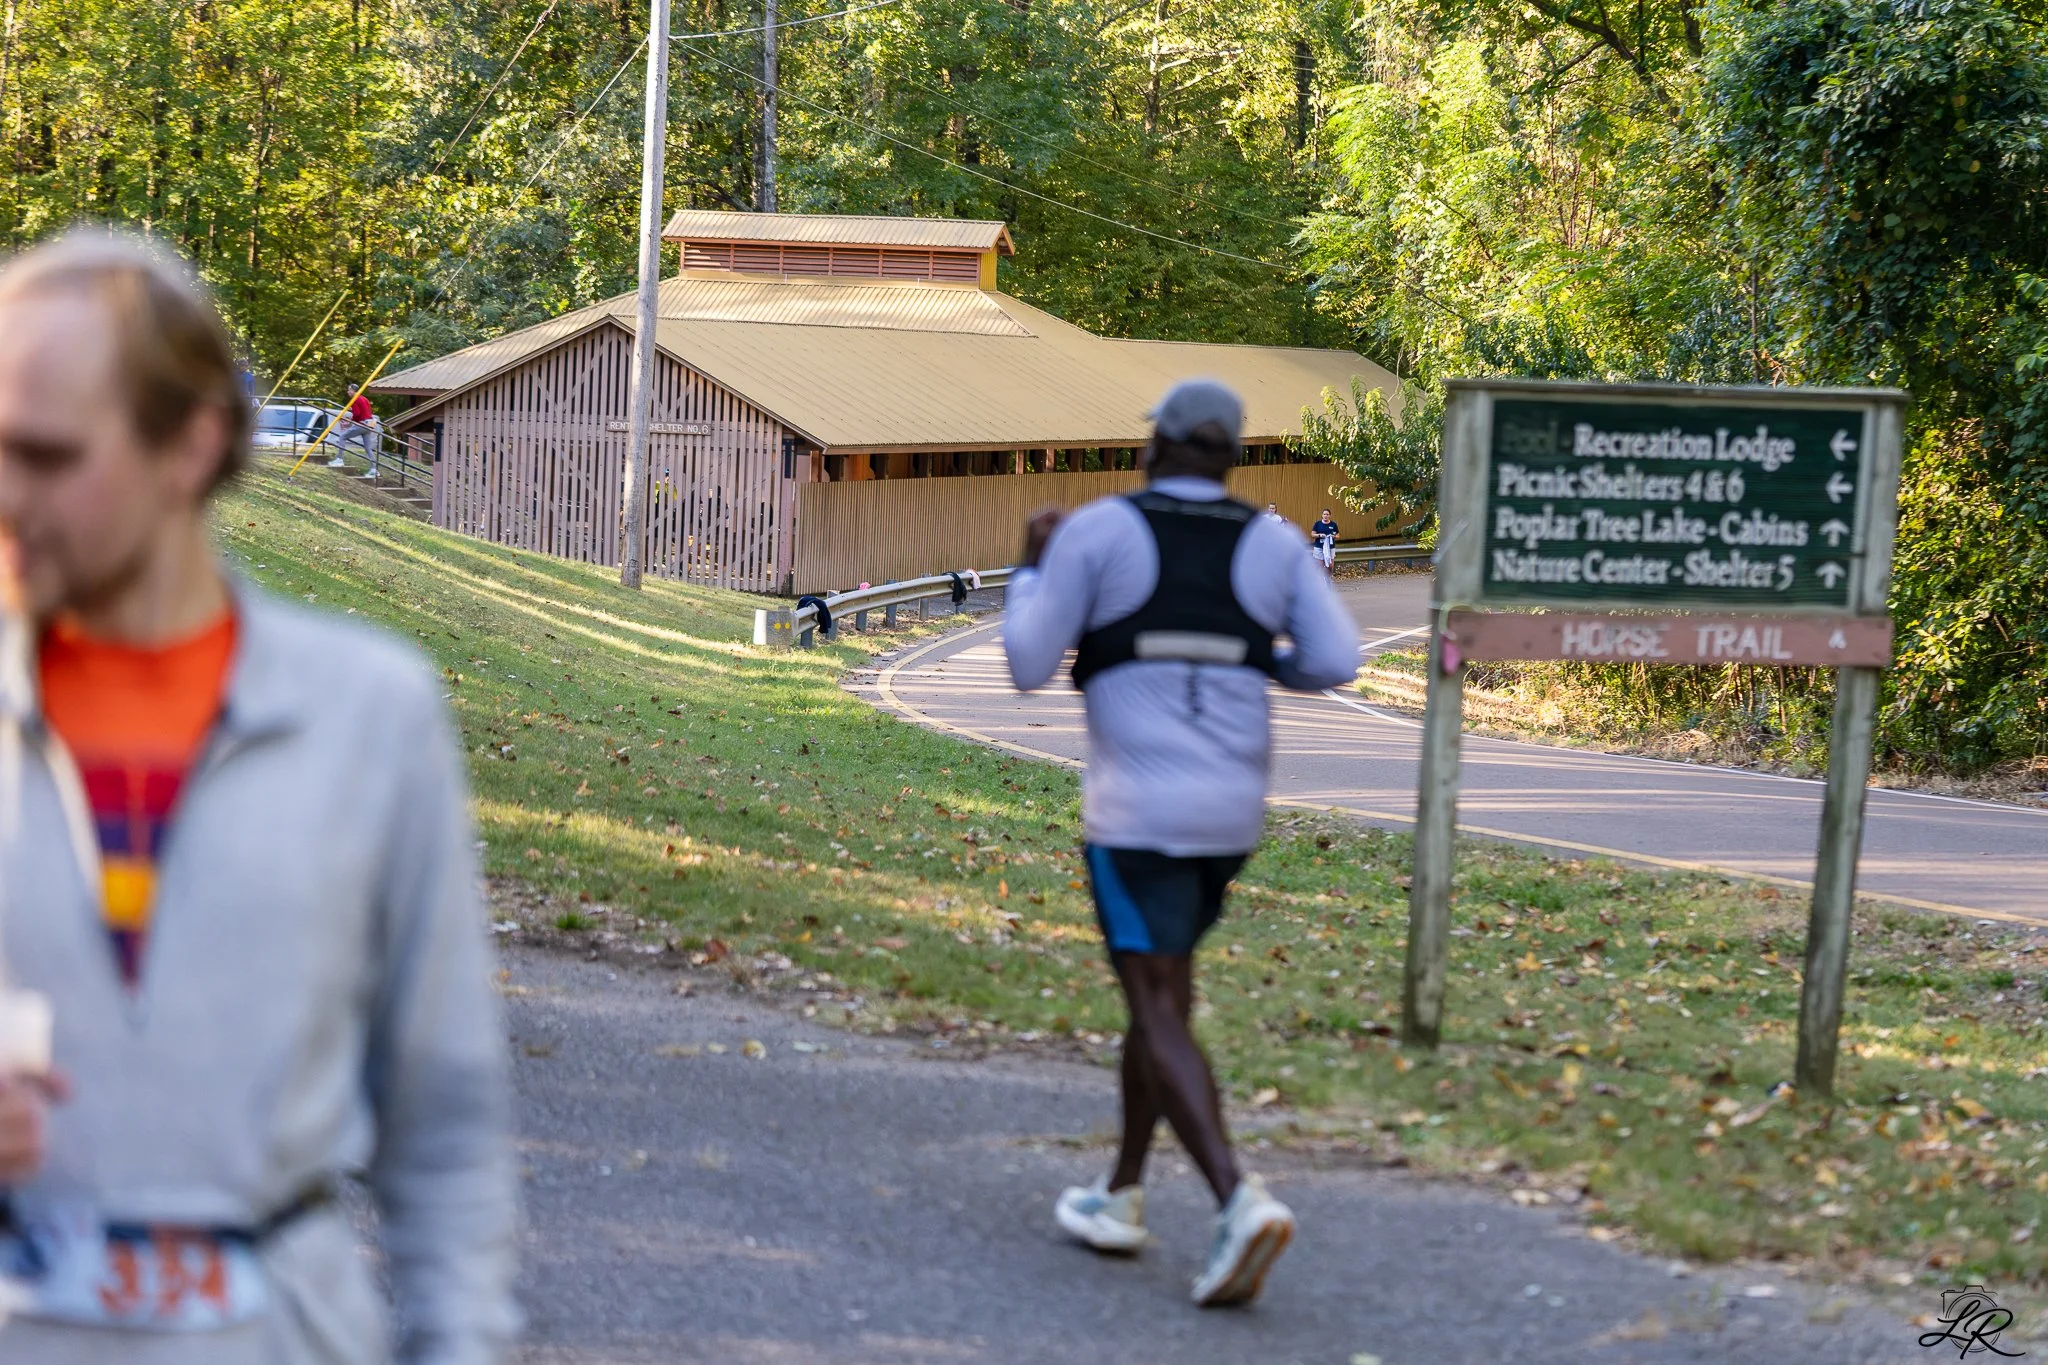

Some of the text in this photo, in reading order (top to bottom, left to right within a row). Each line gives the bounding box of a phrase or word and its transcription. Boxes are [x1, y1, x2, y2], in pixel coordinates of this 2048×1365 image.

[610, 421, 631, 430] RENT
[1574, 422, 1712, 460] Recreation
[1715, 425, 1795, 472] Lodge
[1497, 464, 1578, 499] Picnic
[1579, 464, 1683, 501] Shelters
[1494, 504, 1581, 549] Poplar
[1582, 508, 1641, 541] Tree
[1642, 508, 1706, 543] Lake
[1719, 509, 1809, 545] Cabins
[1492, 549, 1582, 582] Nature
[1582, 550, 1671, 585] Center
[1684, 549, 1773, 587] Shelter
[1774, 555, 1797, 591] 5
[1561, 621, 1793, 660] HORSE TRAIL
